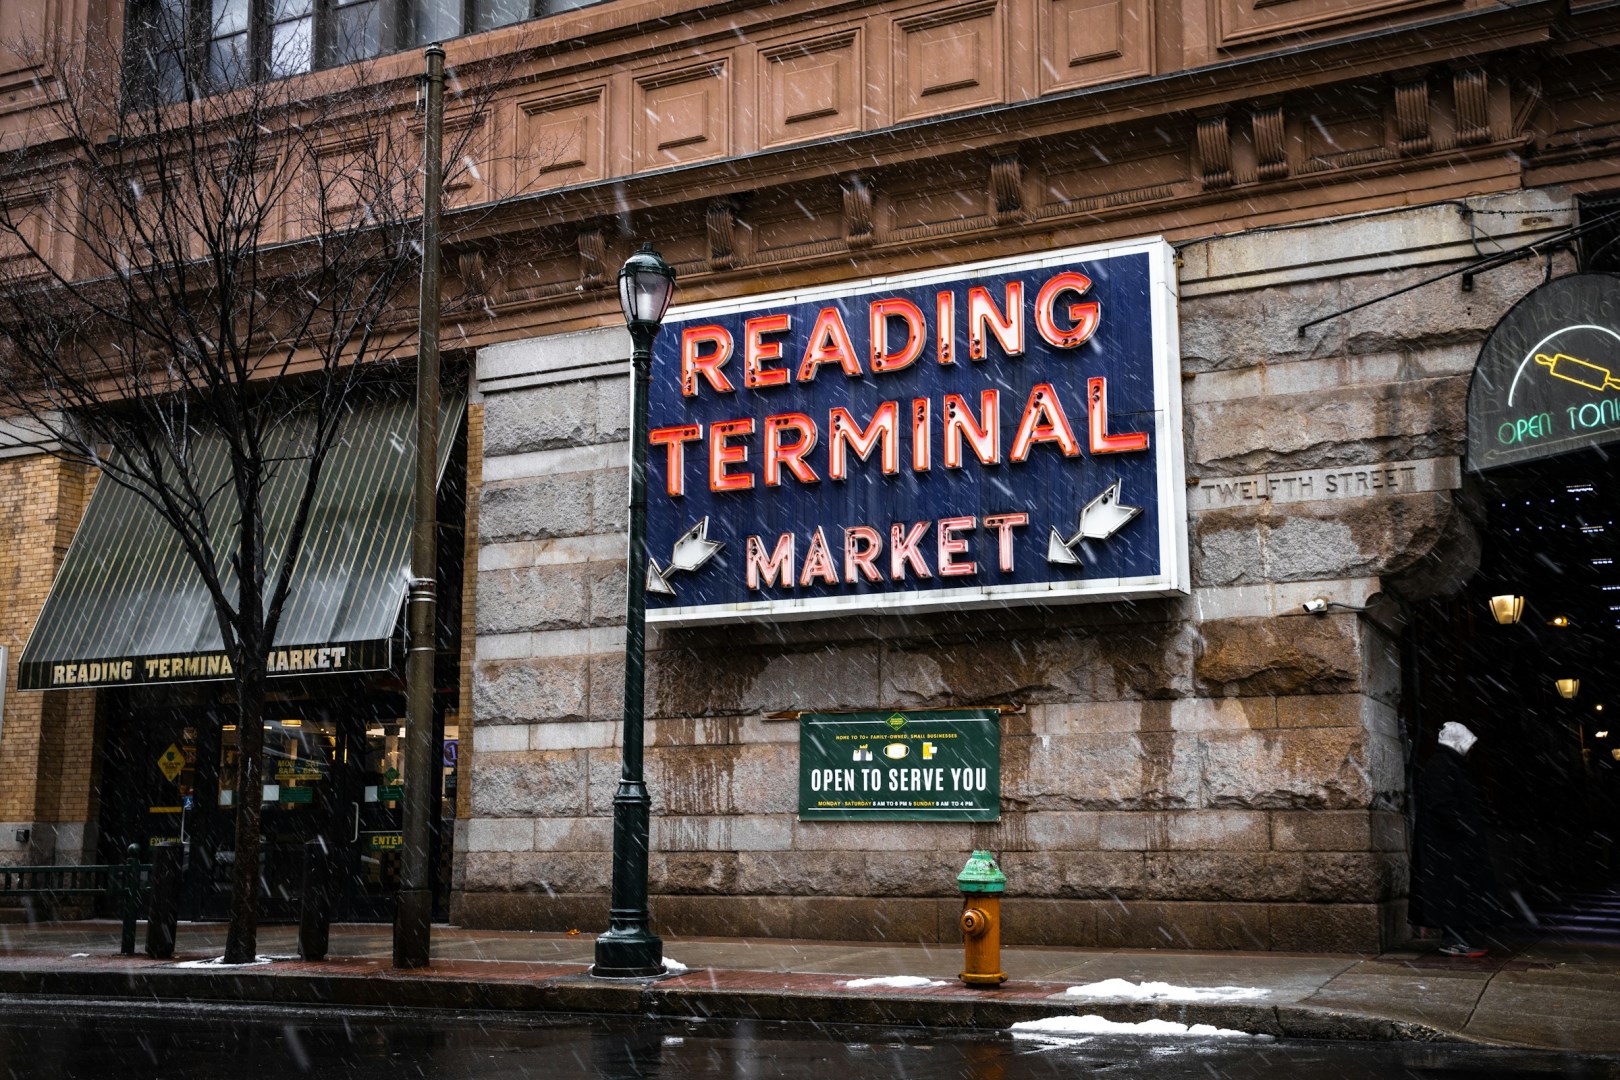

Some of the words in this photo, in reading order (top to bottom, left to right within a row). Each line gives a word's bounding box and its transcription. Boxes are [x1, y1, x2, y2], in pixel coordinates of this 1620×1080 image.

[682, 271, 1101, 397] READING
[649, 376, 1149, 497] TERMINAL
[1498, 412, 1552, 445] OPEN
[1566, 398, 1620, 430] TONI
[1201, 476, 1313, 504] TWELFTH
[1325, 466, 1416, 493] STREET
[746, 512, 1029, 591] MARKET
[53, 660, 133, 685] READING
[145, 654, 233, 679] TERMINA
[811, 768, 855, 792] OPEN
[861, 768, 881, 791] TO
[889, 768, 944, 791] SERVE
[950, 767, 986, 791] YOU
[372, 835, 403, 845] ENTER
